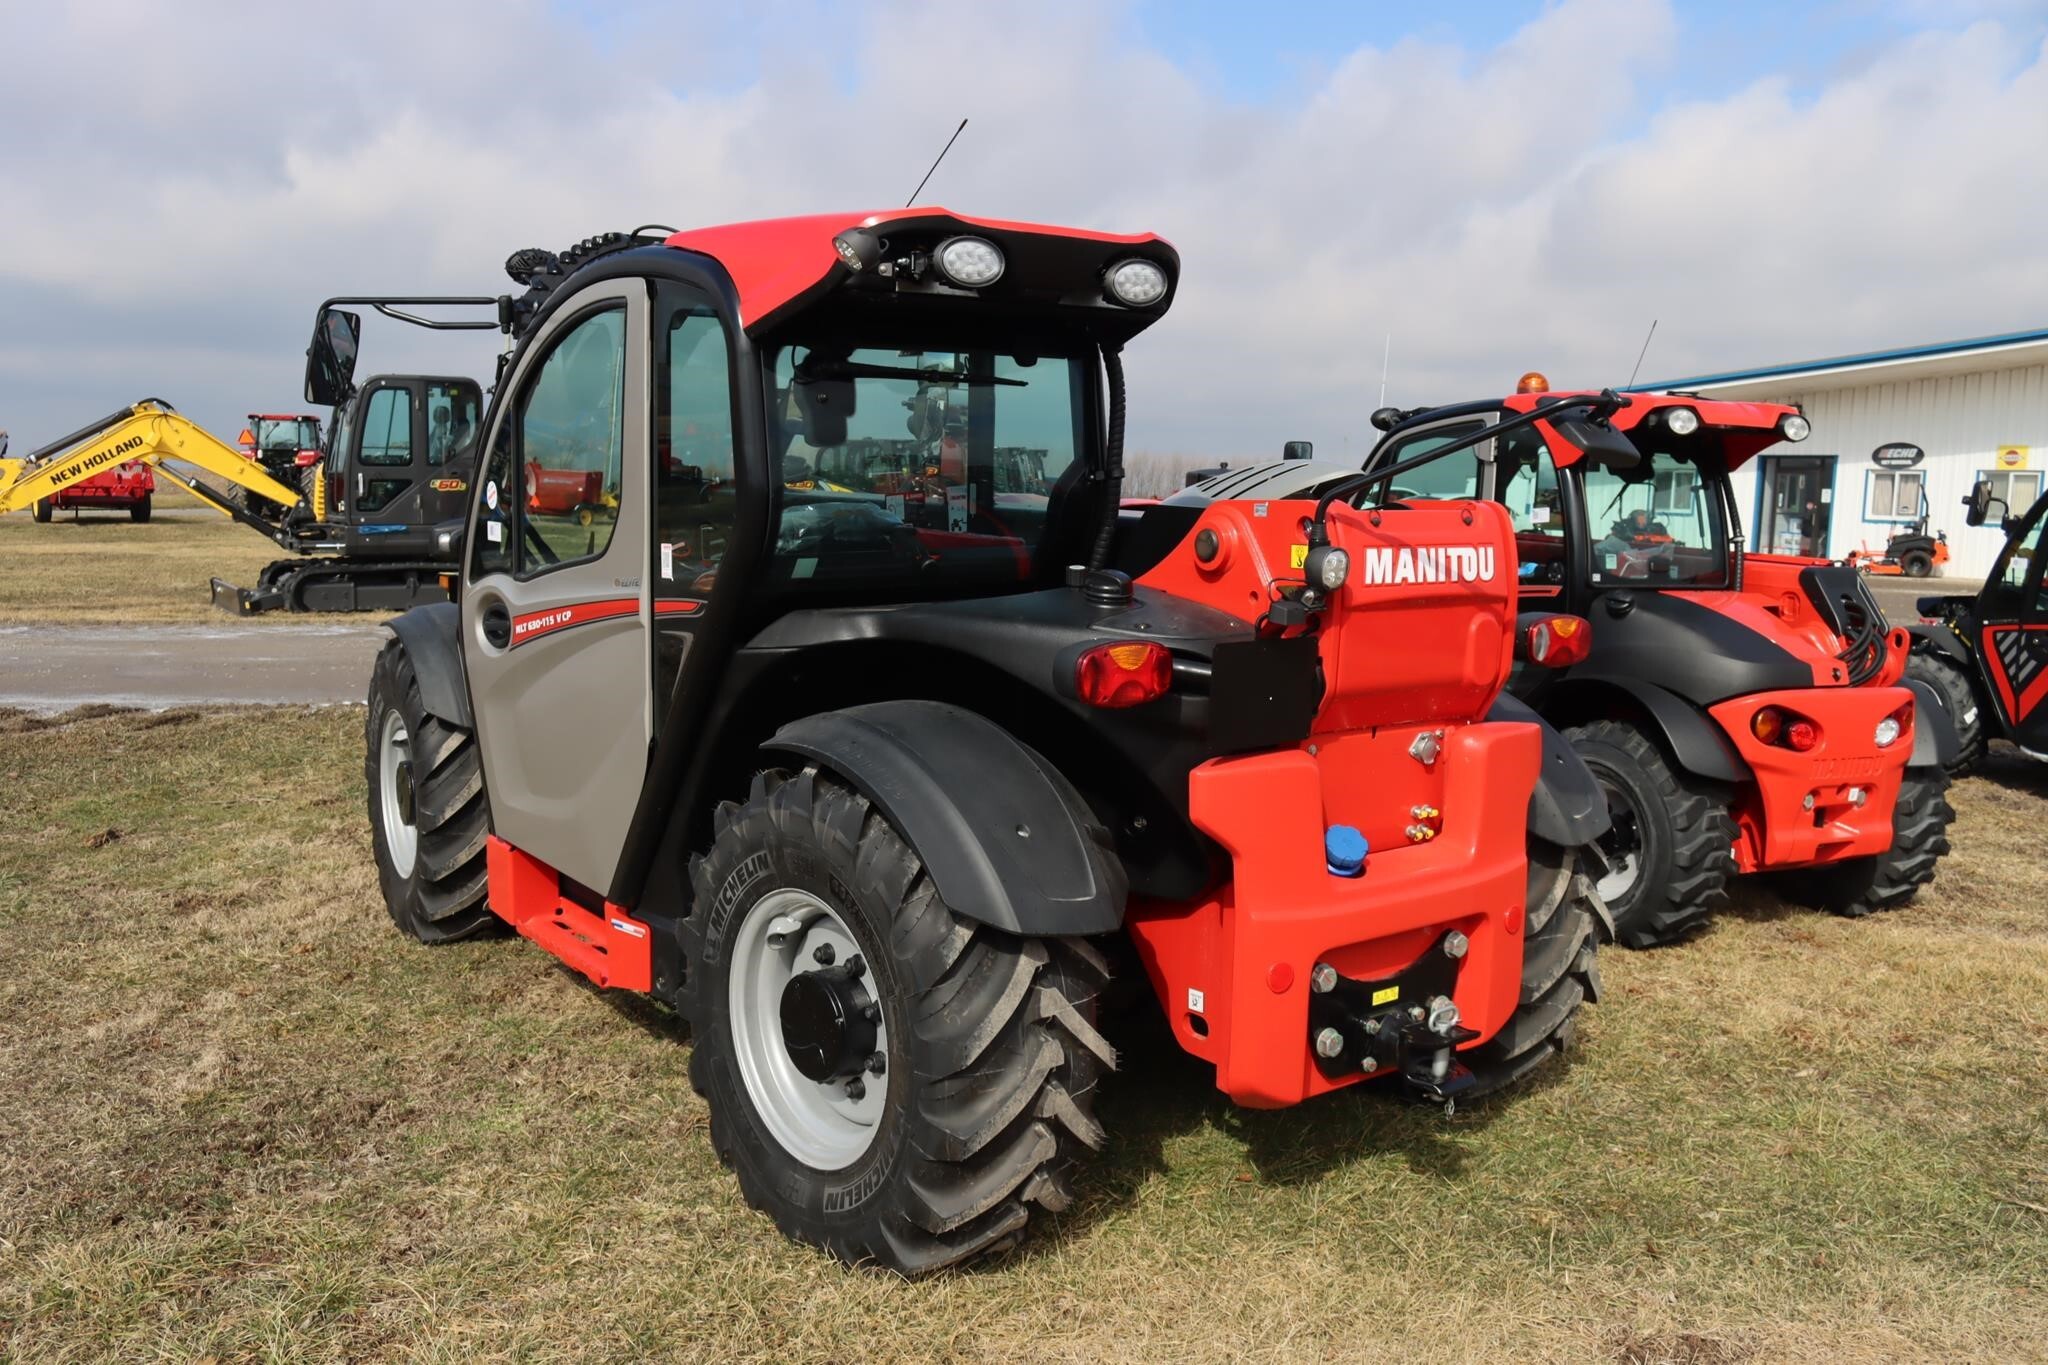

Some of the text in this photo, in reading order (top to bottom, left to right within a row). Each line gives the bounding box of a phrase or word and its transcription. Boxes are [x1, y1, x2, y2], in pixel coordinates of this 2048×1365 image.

[50, 435, 144, 485] NEW HOLLAND
[1887, 448, 1918, 458] ECHO
[1364, 546, 1495, 585] MANITOU
[562, 610, 572, 621] CP
[1808, 755, 1886, 781] MANITOU
[710, 852, 770, 934] MICHELIN
